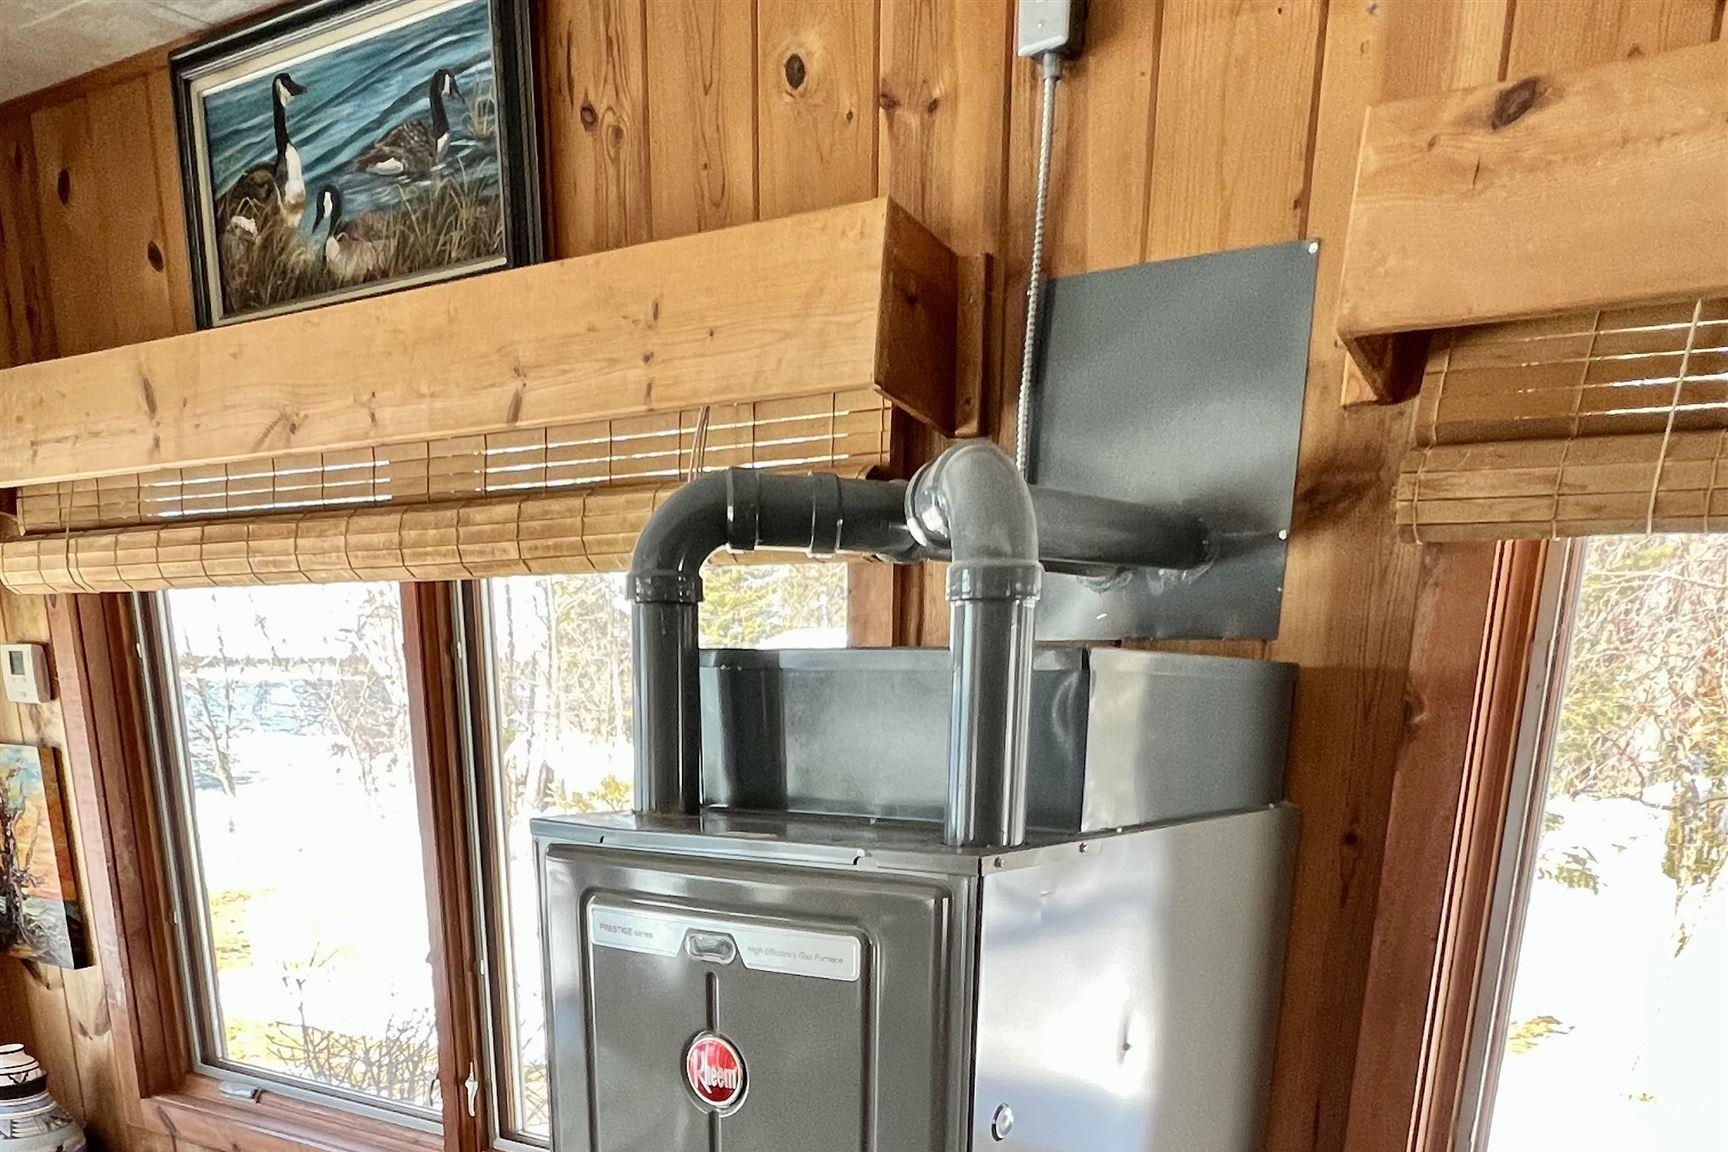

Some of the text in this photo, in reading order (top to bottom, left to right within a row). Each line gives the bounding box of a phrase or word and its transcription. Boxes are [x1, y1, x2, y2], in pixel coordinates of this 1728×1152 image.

[600, 923, 633, 936] PRESTIGE
[747, 945, 764, 956] High
[764, 947, 797, 960] Efficiency
[814, 953, 844, 964] Furnace
[693, 1044, 738, 1094] Rheem
